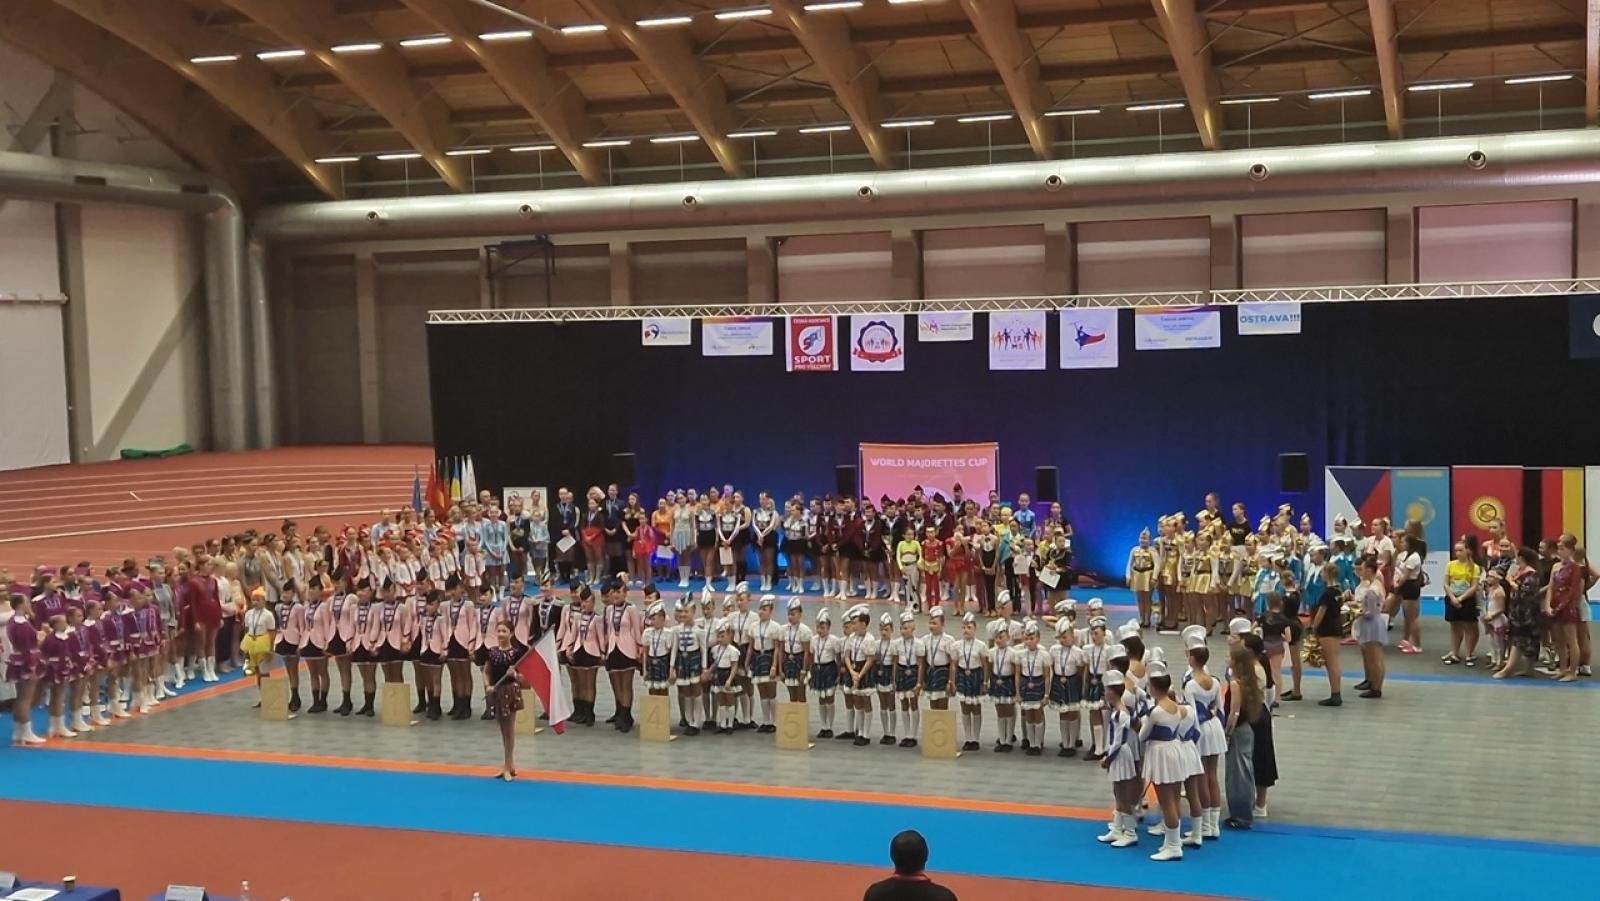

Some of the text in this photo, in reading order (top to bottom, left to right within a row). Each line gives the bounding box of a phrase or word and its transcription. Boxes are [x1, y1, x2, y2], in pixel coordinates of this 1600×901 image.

[1240, 314, 1300, 323] OSTRAVA!!!
[794, 355, 831, 364] SPORT
[871, 457, 989, 469] WORLD MAJORETTES CUP
[647, 704, 661, 729] 4
[784, 711, 800, 738] 5
[930, 719, 949, 748] 6
